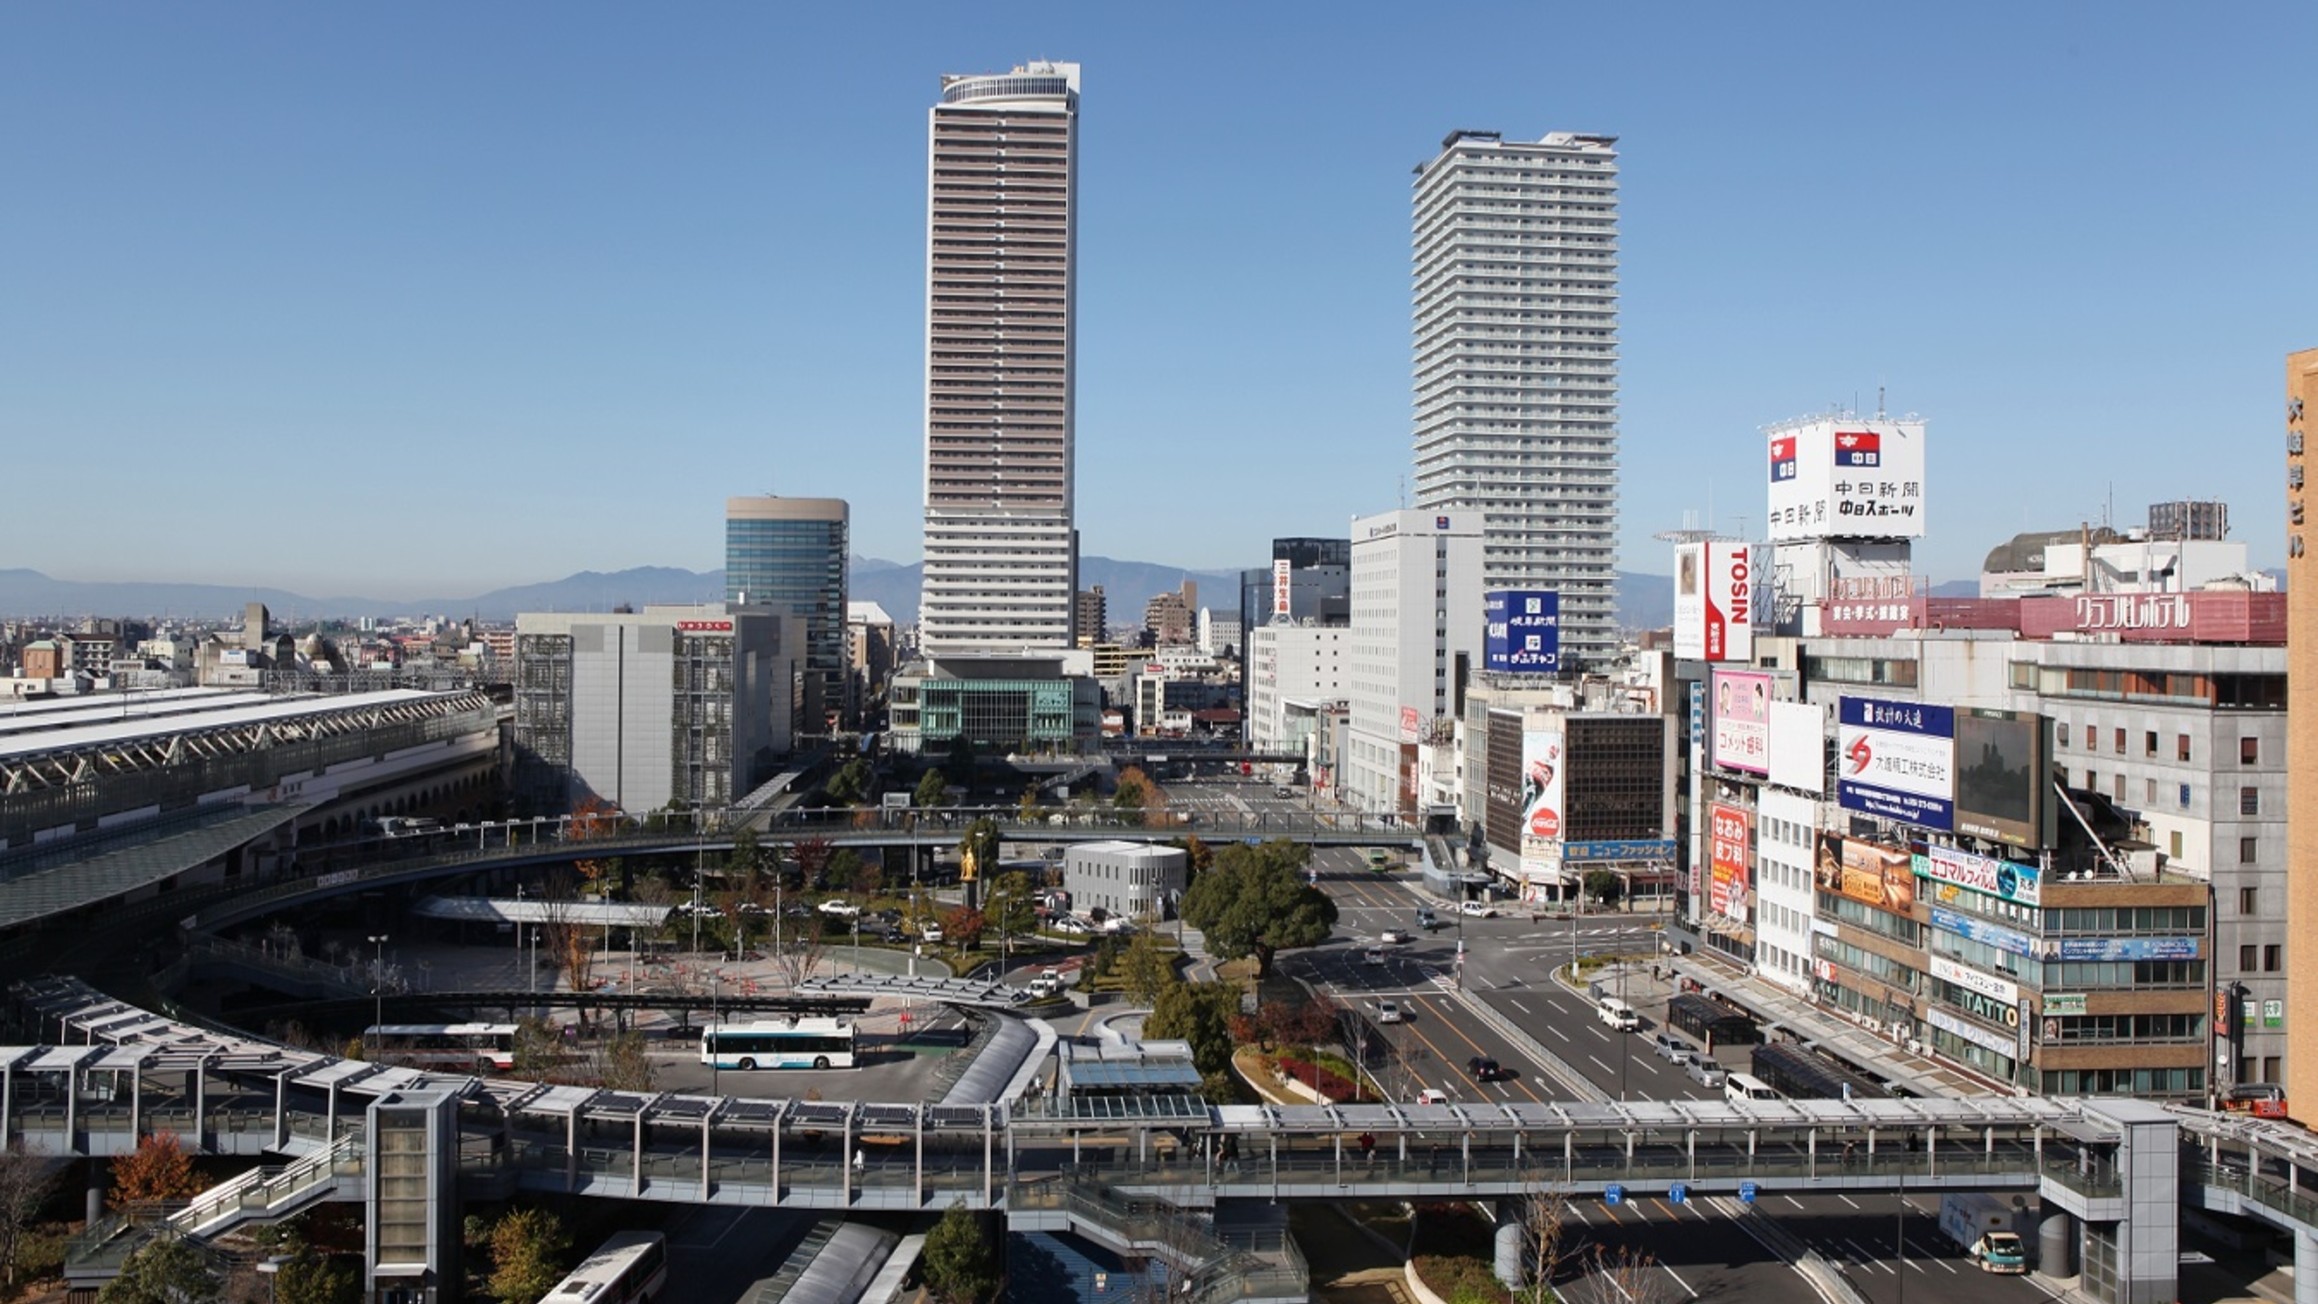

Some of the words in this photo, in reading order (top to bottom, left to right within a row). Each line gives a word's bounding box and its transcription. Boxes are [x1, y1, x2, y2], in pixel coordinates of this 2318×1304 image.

[1835, 480, 1919, 498] 中日新聞
[2287, 396, 2304, 558] 大岐阜ビル
[1771, 499, 1826, 528] 中日新聞
[1839, 500, 1914, 518] 中日スポーツ
[1731, 547, 1748, 624] TOSIN
[2077, 595, 2190, 628] グランパレホテル
[1511, 649, 1555, 664] ぎふチャン
[1720, 732, 1763, 756] コメット歯科
[1715, 815, 1743, 841] なおみ
[1715, 840, 1743, 867] 皮フ科
[1931, 858, 1997, 892] エコマルフィルム
[1963, 989, 2018, 1027] TATTO
